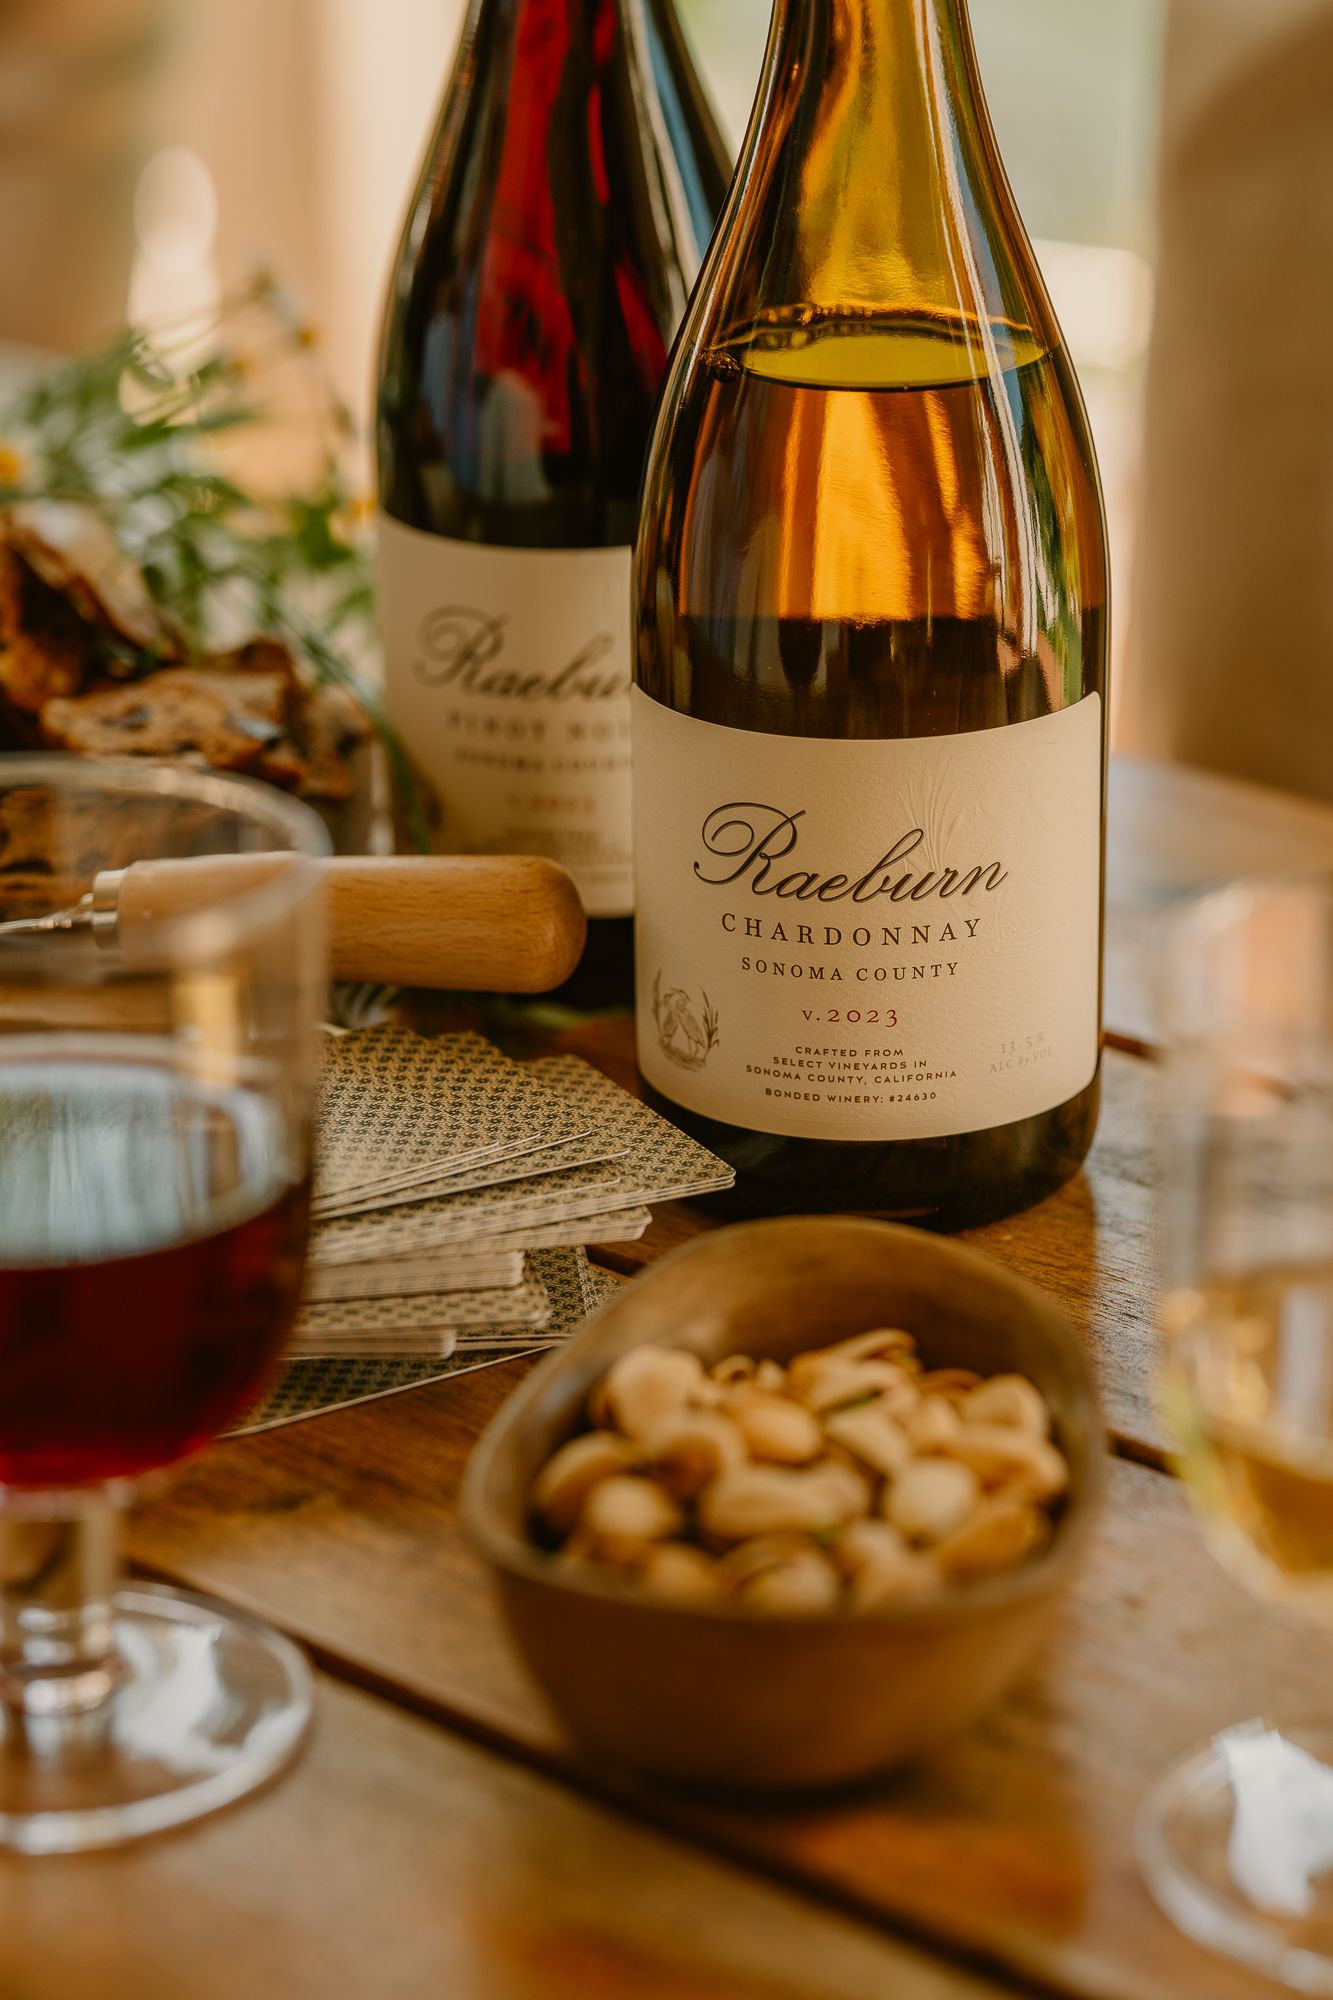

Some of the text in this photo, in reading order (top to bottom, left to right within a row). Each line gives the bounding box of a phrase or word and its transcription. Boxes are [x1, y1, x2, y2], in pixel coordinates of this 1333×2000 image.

[412, 604, 632, 702] Raebu
[693, 802, 1009, 904] Raeburn
[721, 913, 981, 947] CHARDONNAY
[741, 956, 960, 982] SONOMA COUNTY
[801, 1008, 898, 1028] v.2023
[795, 1046, 904, 1057] CRAFTED FROM
[773, 1056, 928, 1071] SELECT VINEYARDS IN
[746, 1064, 957, 1085] SONOMA COUNTY, CALIFORNIA
[765, 1087, 937, 1104] BONDED WINERY: #24630
